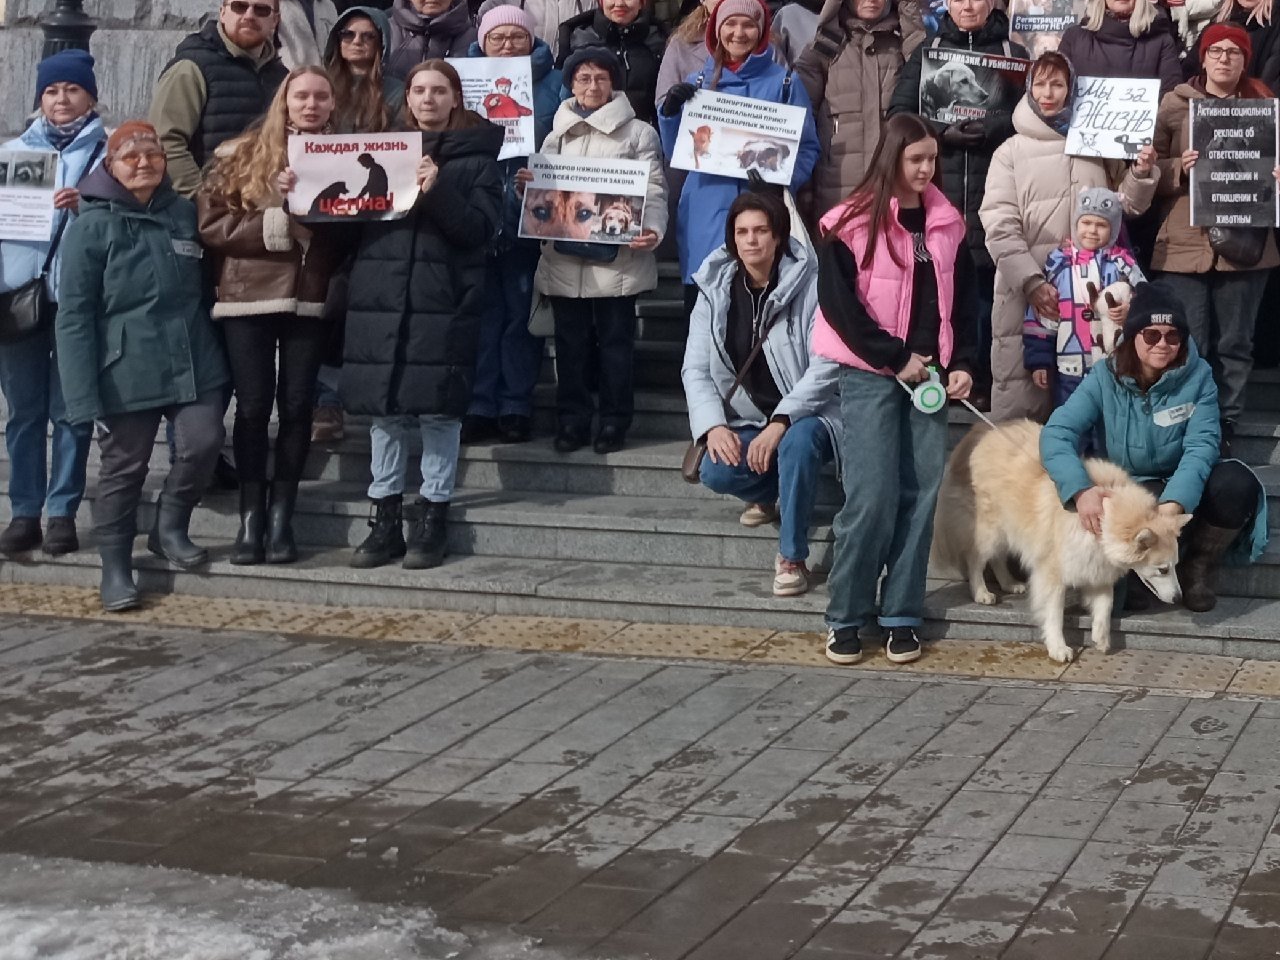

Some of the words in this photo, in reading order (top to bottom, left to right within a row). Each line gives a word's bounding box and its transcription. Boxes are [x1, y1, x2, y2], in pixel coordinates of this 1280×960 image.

[1064, 16, 1075, 24] ДА
[928, 50, 938, 60] НЕ
[982, 58, 988, 66] А
[1077, 79, 1114, 100] Мы
[1118, 88, 1150, 102] за
[1070, 100, 1154, 132] Жизнь
[1197, 103, 1230, 116] Активная
[1230, 107, 1272, 117] социальная
[1214, 128, 1243, 140] реклама
[1245, 126, 1254, 138] об
[304, 142, 360, 154] Каждая
[364, 141, 408, 152] жизнь
[1208, 150, 1260, 160] ответственном
[602, 168, 645, 176] НАКАЗЫВАТЬ
[1253, 172, 1258, 180] и
[320, 192, 394, 216] ценна!
[1212, 193, 1251, 202] отношении
[1252, 193, 1258, 202] к
[1216, 214, 1252, 224] животным
